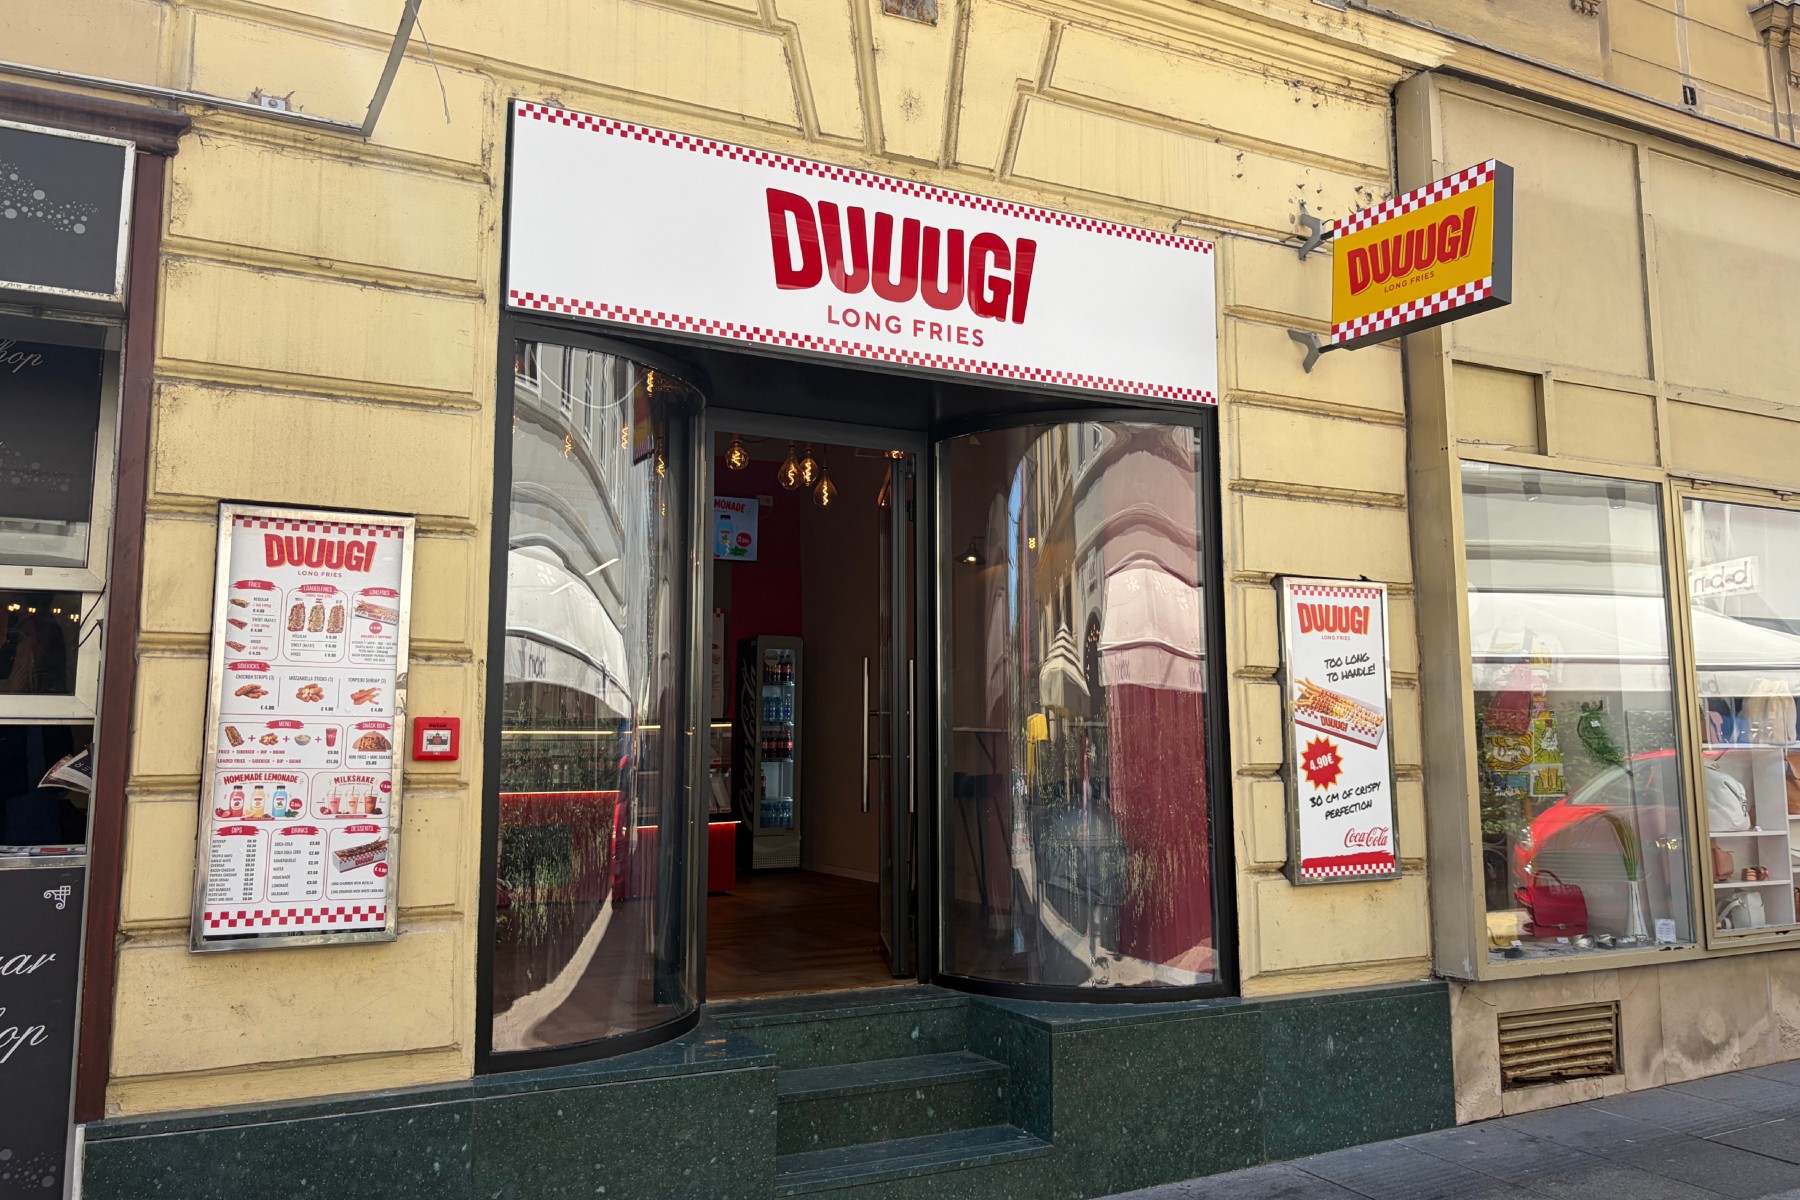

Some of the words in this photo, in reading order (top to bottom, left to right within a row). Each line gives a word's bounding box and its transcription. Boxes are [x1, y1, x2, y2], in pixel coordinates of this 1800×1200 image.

[766, 187, 1037, 325] DUUUGI
[1347, 205, 1479, 296] DUUUGI
[1384, 280, 1408, 293] LONG
[1410, 271, 1435, 284] FRIES
[827, 305, 902, 334] LONG
[913, 319, 984, 347] FRIES
[264, 533, 378, 574] DUUUGI
[1297, 602, 1370, 636] DUUUGI
[1324, 657, 1343, 668] TOO
[1345, 652, 1370, 665] LONG
[1326, 672, 1339, 682] TO
[1341, 663, 1376, 680] HANDLE!
[1320, 715, 1348, 732] DUUUGI
[1310, 752, 1334, 771] 4.90€
[224, 773, 262, 784] HOMEMADE
[264, 773, 299, 783] LEMONADE
[334, 775, 375, 784] MILKSHAKE
[1309, 796, 1323, 808] 30
[1326, 792, 1340, 804] CM
[1342, 788, 1354, 800] OF
[1355, 781, 1381, 796] CRISPY
[1325, 799, 1373, 820] PERFECTION
[1344, 826, 1389, 849] Coca-Cola
[0, 953, 56, 976] ar
[0, 1007, 48, 1064] op
